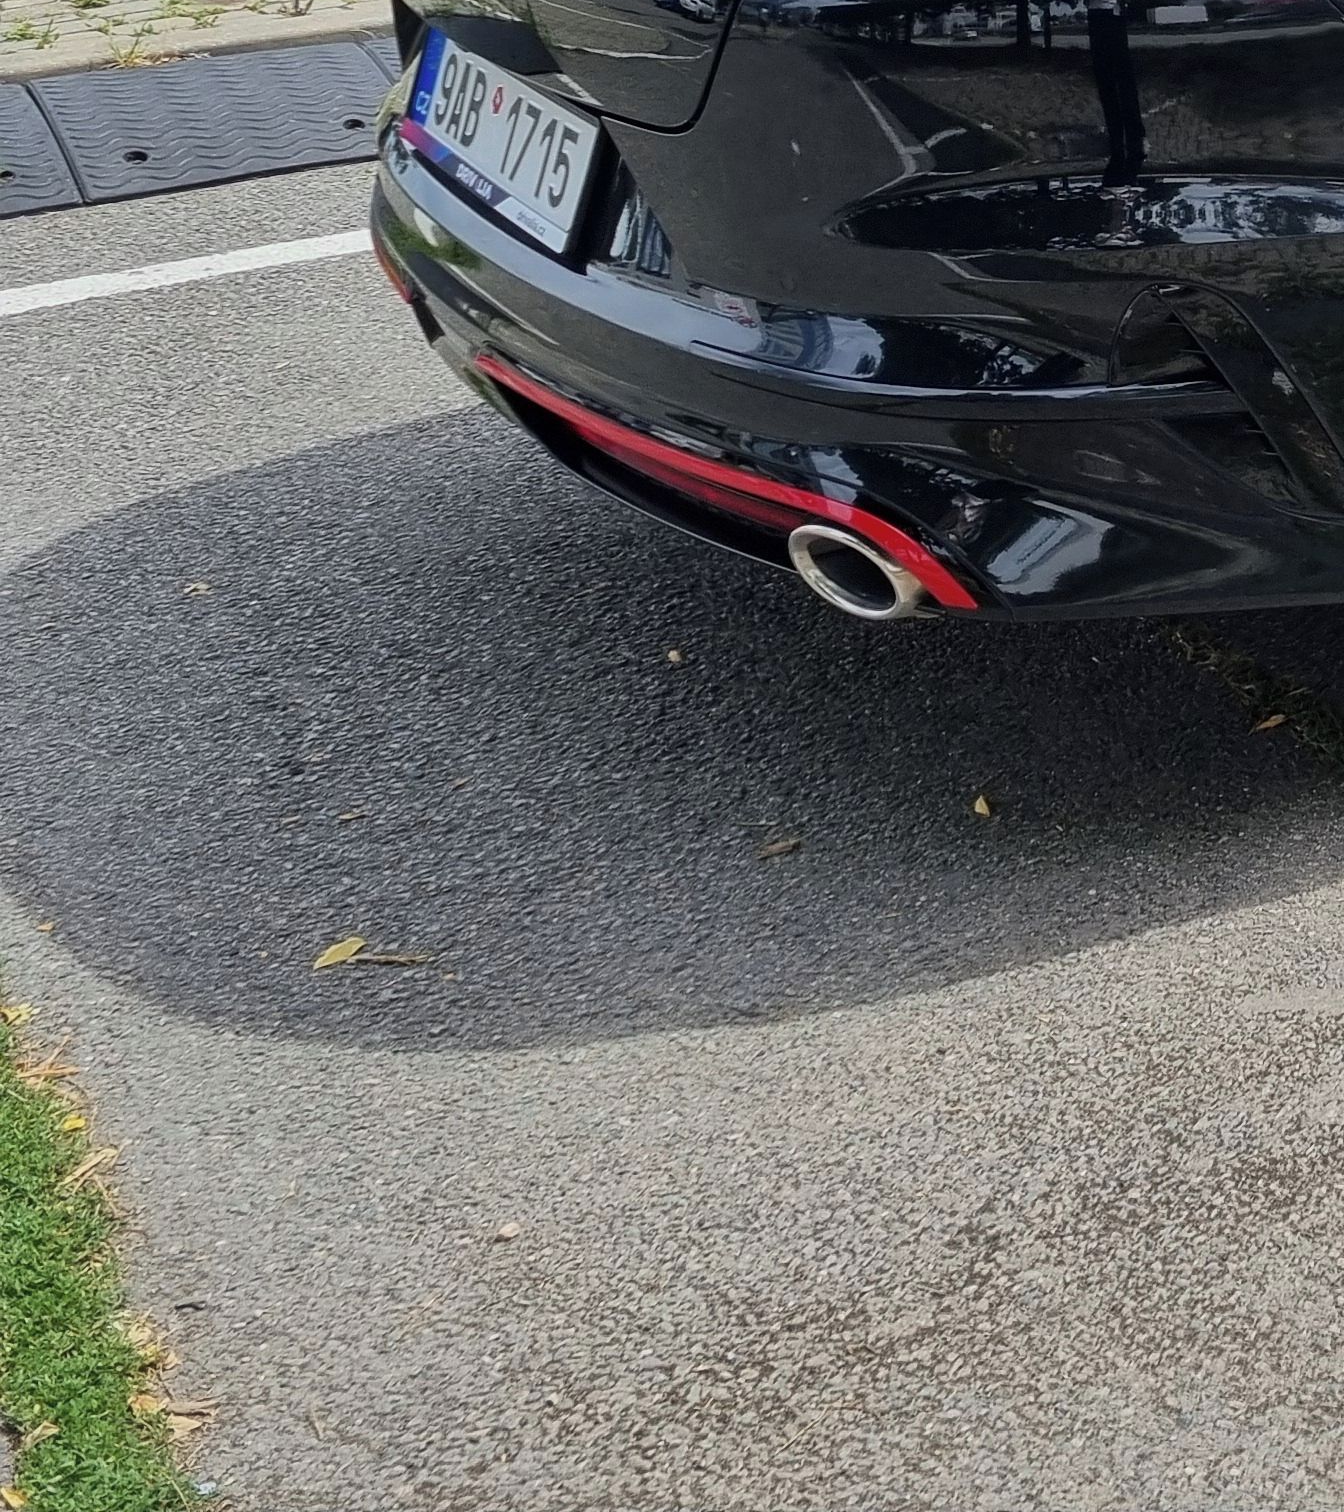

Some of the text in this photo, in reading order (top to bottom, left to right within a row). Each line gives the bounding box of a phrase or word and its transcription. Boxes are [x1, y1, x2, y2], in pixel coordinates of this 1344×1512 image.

[415, 90, 431, 115] CZ
[434, 53, 580, 208] 9AB 1715
